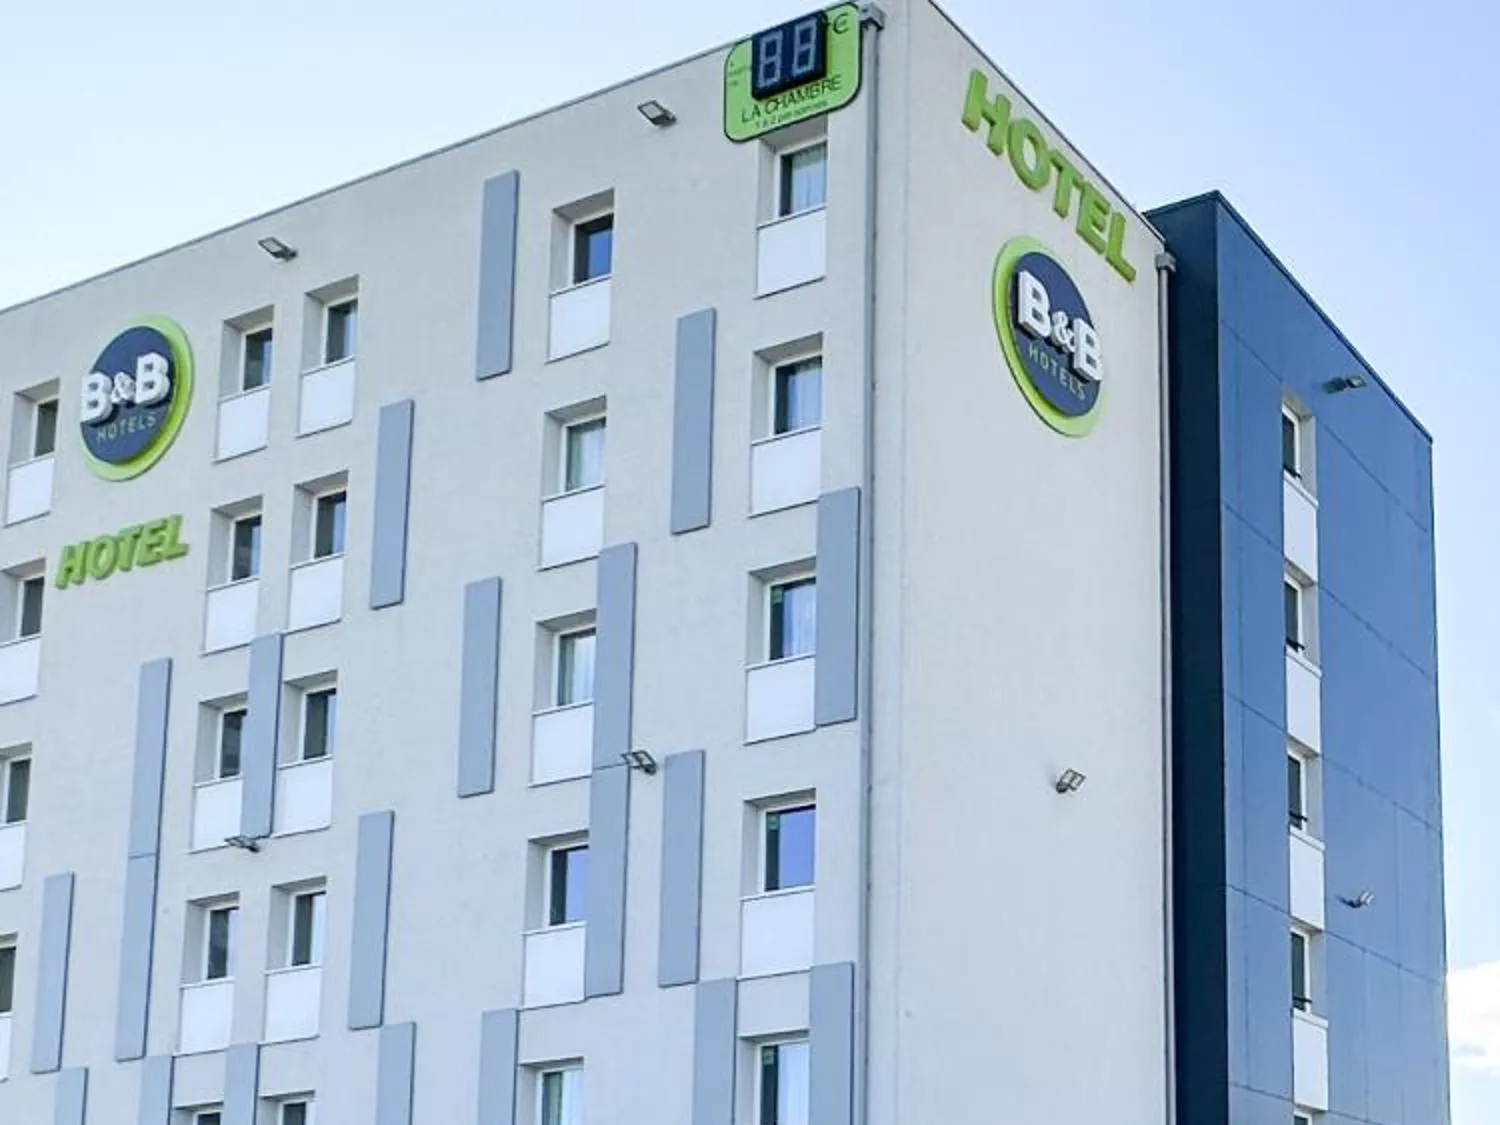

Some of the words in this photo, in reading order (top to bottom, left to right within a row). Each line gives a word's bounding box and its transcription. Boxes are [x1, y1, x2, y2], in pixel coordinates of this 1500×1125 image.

[741, 103, 761, 123] LA
[765, 74, 843, 114] CHAMBRE
[961, 68, 1136, 284] HOTEL
[1017, 269, 1103, 382] B&B
[80, 352, 171, 425] B&B
[1028, 342, 1087, 401] HOTELS
[96, 412, 157, 443] HOTELS
[54, 513, 191, 591] HOTEL
